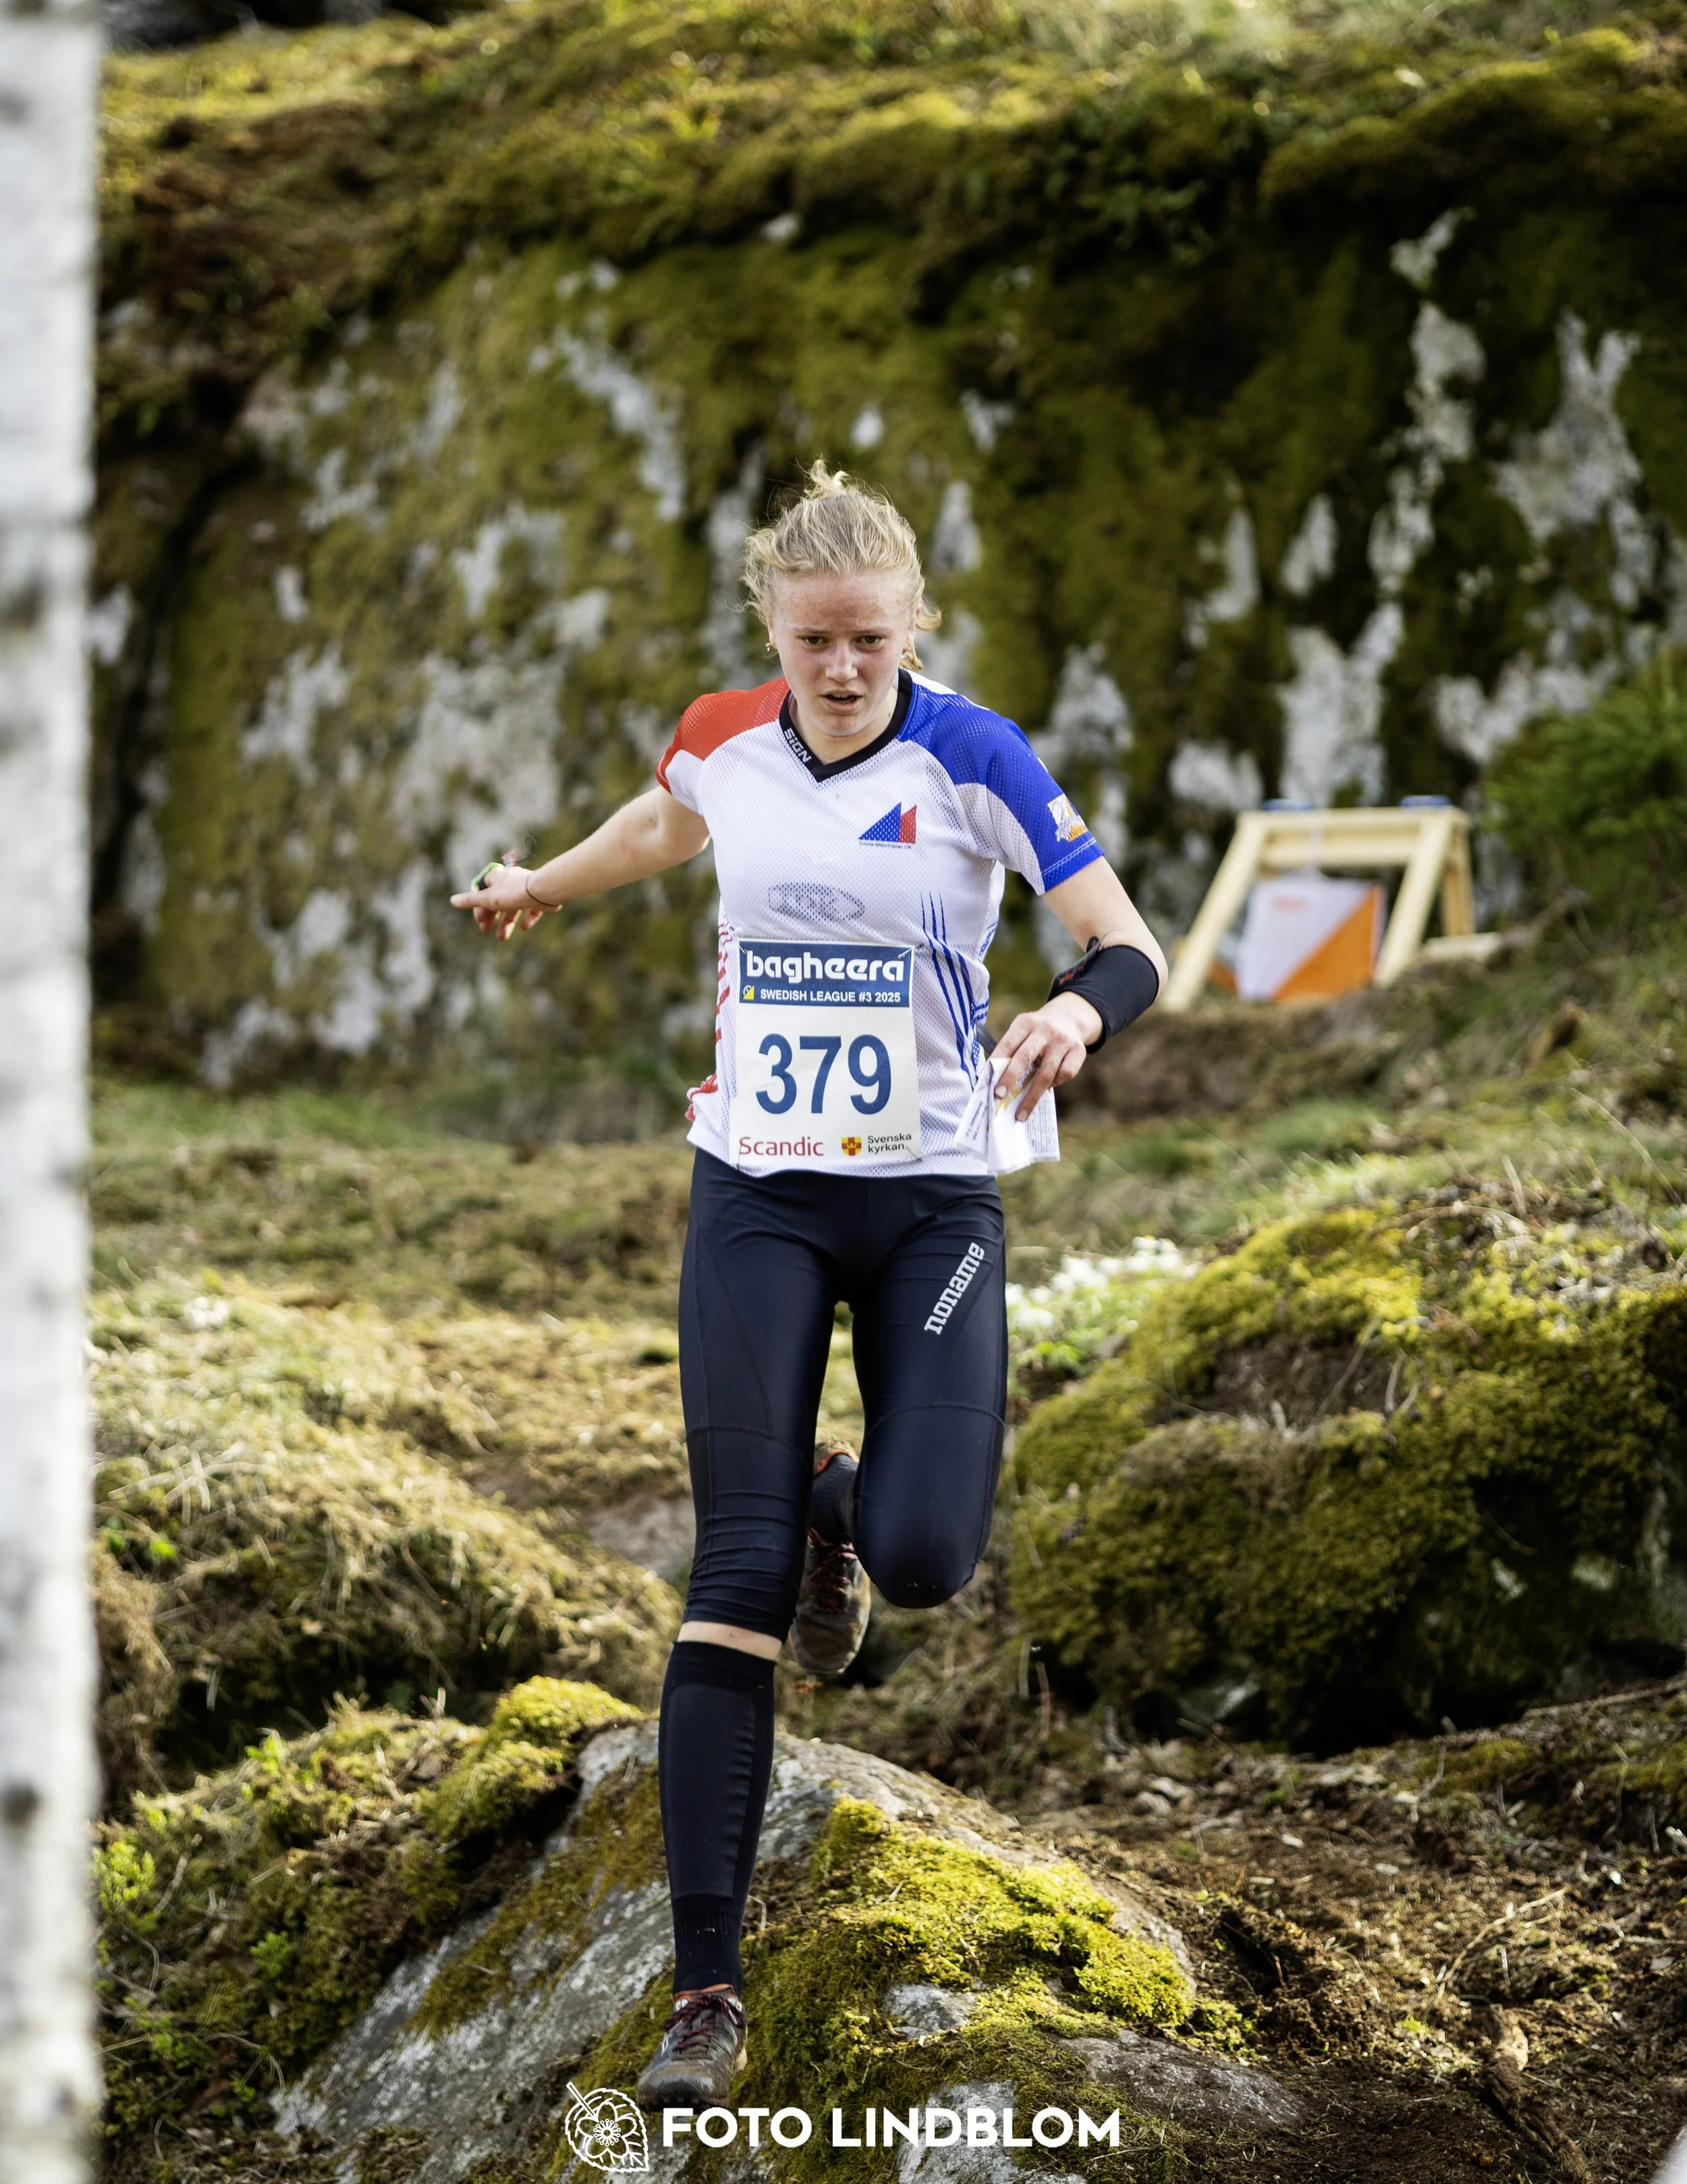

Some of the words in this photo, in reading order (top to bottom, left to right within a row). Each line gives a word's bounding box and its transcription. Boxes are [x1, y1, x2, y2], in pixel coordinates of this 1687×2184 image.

[746, 950, 904, 983] bagheera
[760, 988, 807, 1001] SWEDISH
[810, 991, 856, 1002] LEAGUE
[858, 991, 872, 1002] #3
[875, 991, 901, 1003] 2025
[756, 1033, 891, 1115] 379
[739, 1137, 824, 1156] Scandic
[867, 1132, 912, 1144] Svenska
[868, 1143, 904, 1155] kyrkan
[923, 1242, 985, 1335] noname
